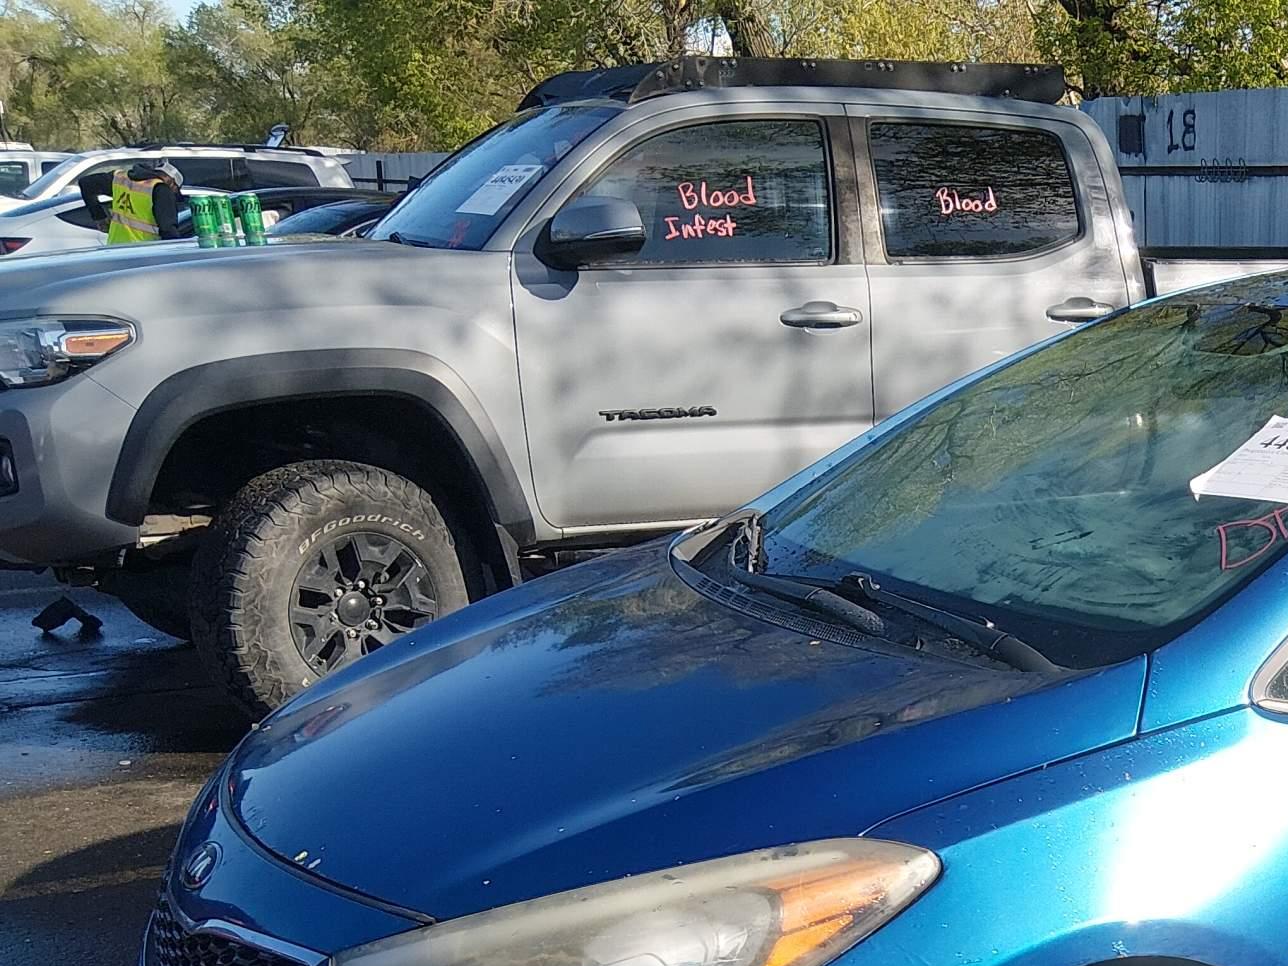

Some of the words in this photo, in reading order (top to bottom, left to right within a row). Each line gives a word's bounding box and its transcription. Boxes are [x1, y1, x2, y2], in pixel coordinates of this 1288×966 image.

[1167, 109, 1196, 153] 18
[677, 175, 757, 211] Blood
[935, 186, 998, 215] Blood
[664, 213, 738, 241] Infest
[598, 405, 718, 421] TACOMA
[298, 513, 426, 555] BFGoodrich
